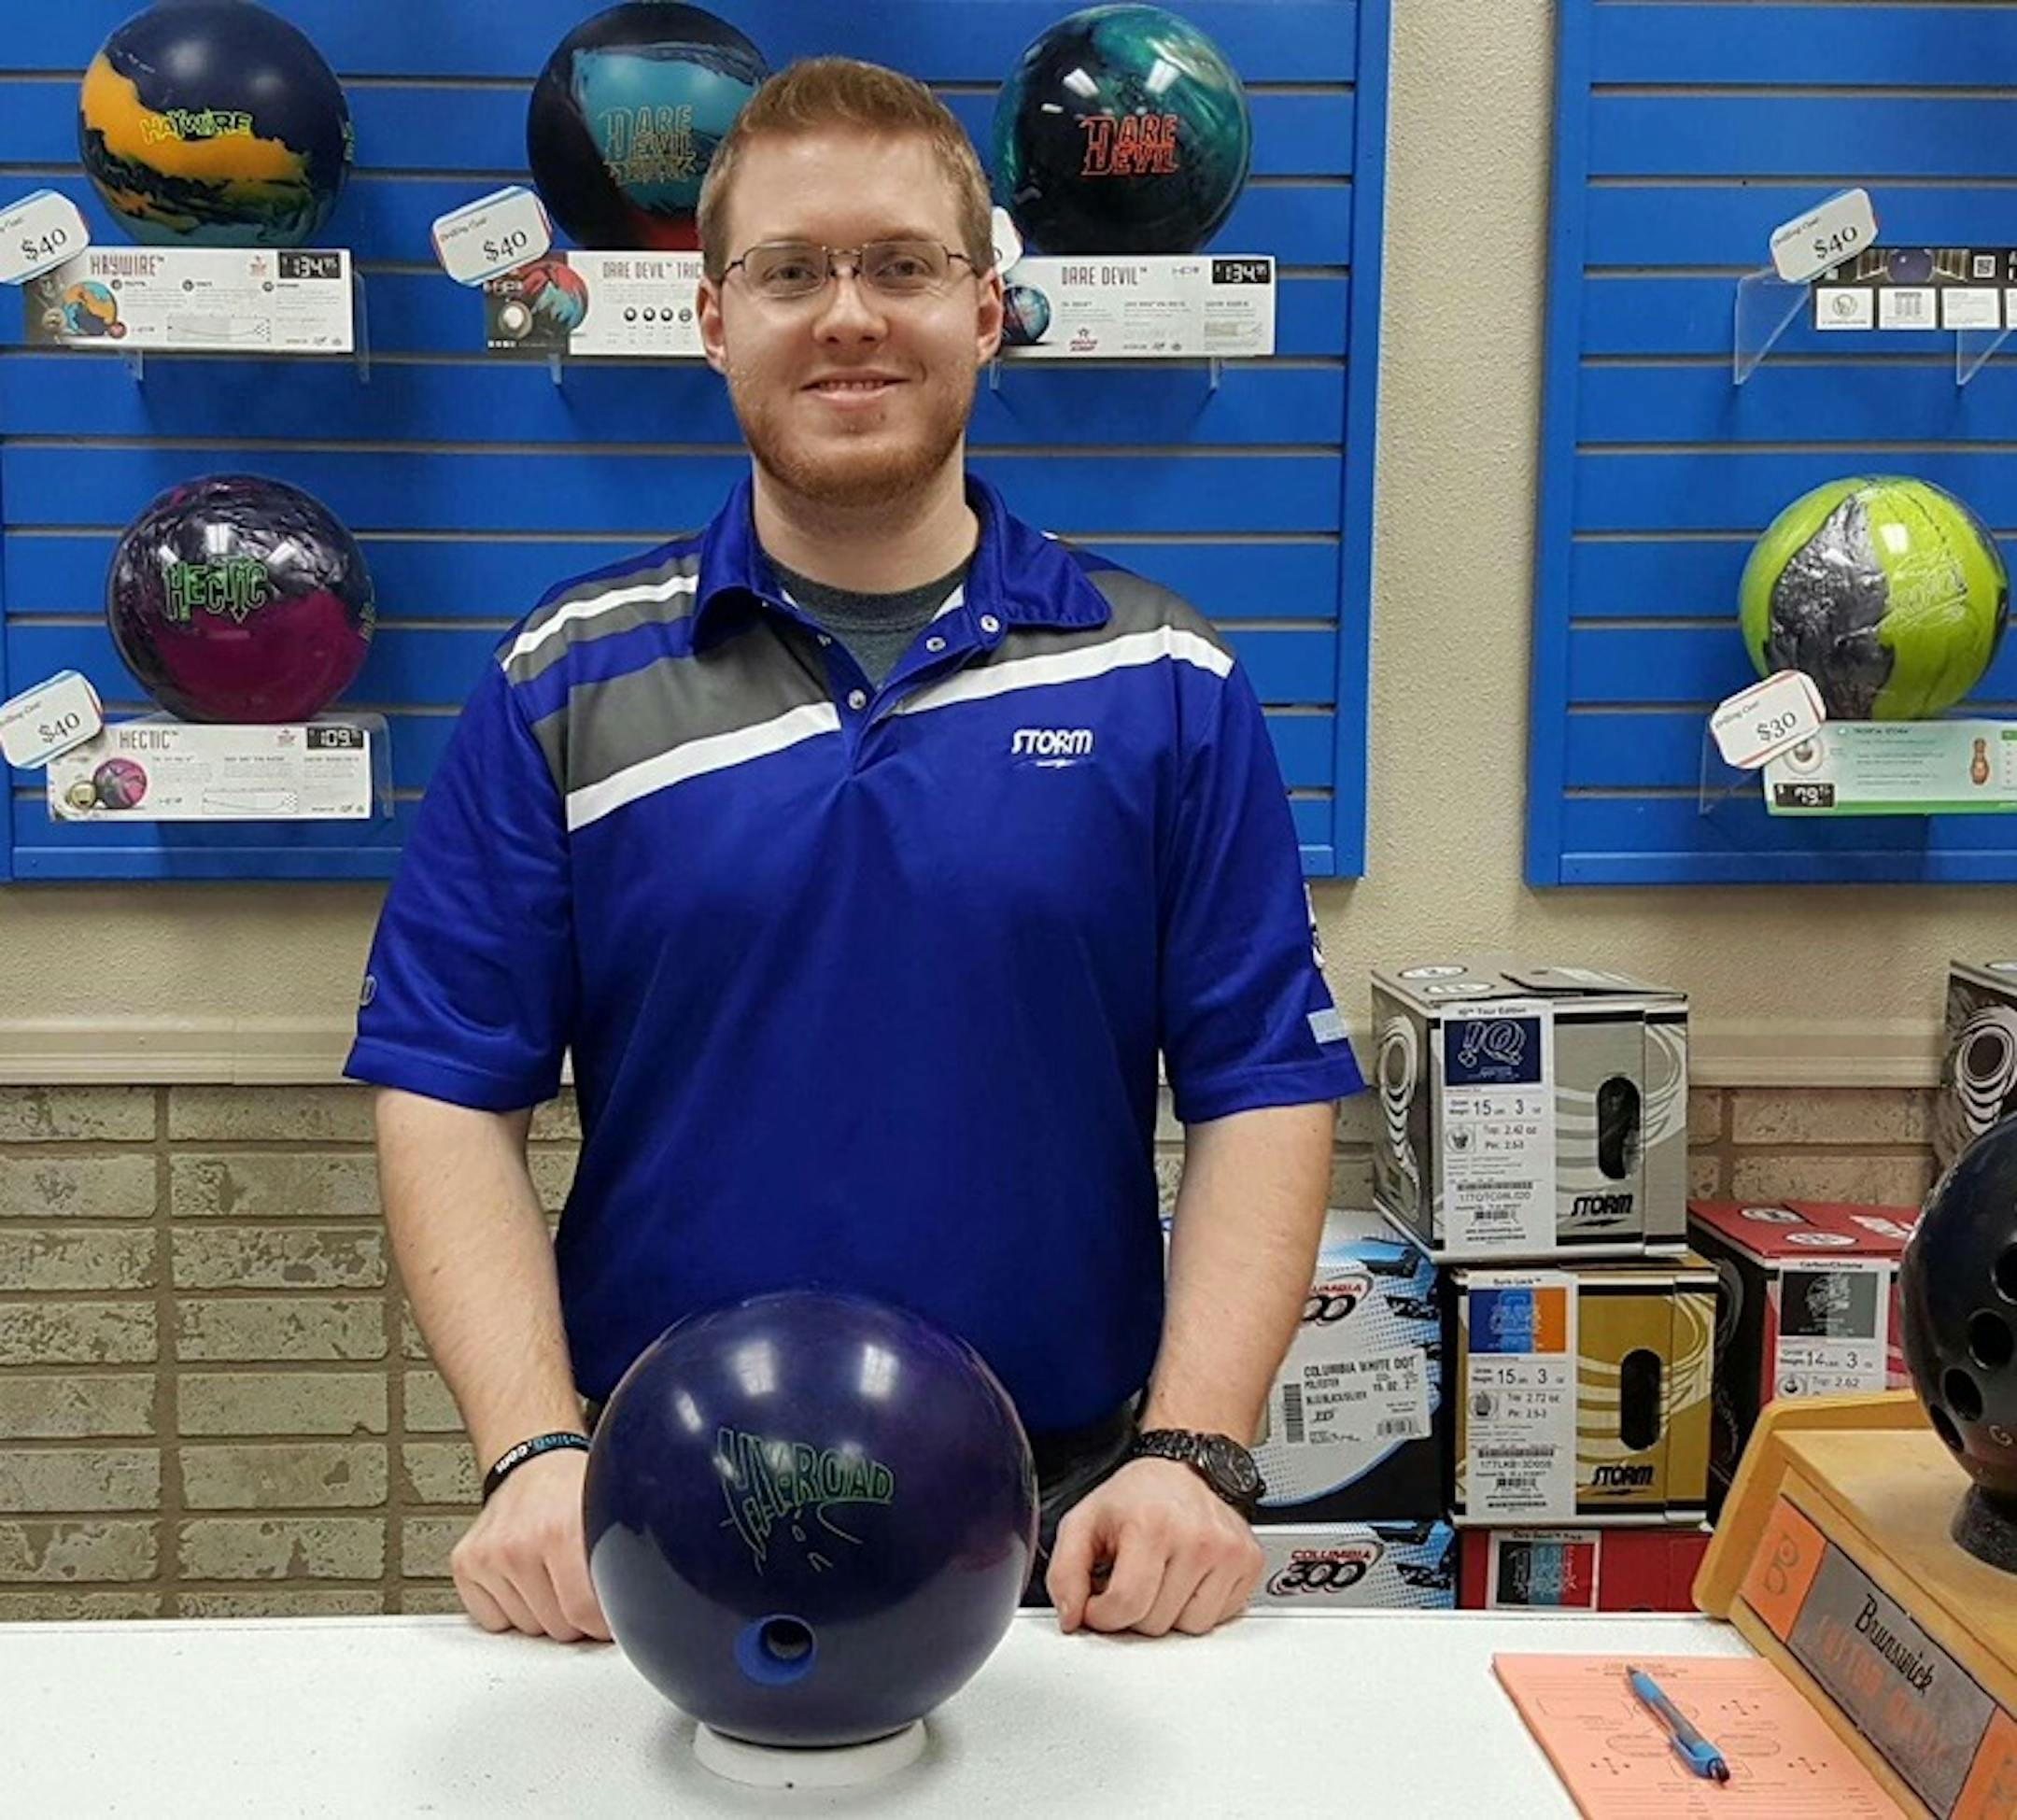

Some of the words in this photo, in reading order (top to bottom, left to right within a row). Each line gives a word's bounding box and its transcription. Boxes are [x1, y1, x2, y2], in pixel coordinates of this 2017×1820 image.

[1081, 141, 1179, 176] DEVIL
[21, 228, 66, 262] $40
[483, 230, 527, 262] $40
[1813, 227, 1857, 260] $40
[1062, 266, 1095, 285] DARE
[164, 555, 269, 624] HECTIC
[38, 712, 80, 743] $40
[1757, 712, 1797, 741] $30
[1011, 728, 1093, 755] STORM
[1474, 1098, 1492, 1116] 15
[1516, 1098, 1524, 1115] 3
[1572, 1194, 1632, 1216] STORM
[1302, 1294, 1356, 1322] 00
[1304, 1362, 1356, 1377] COLUMBIA
[1359, 1359, 1389, 1373] WHITE
[1394, 1355, 1416, 1370] DOT
[1846, 1351, 1858, 1369] 3
[1498, 1368, 1516, 1384] 15
[1538, 1368, 1547, 1384] 3
[1592, 1465, 1653, 1487] STORM
[1291, 1550, 1371, 1561] COLUMBIA
[1281, 1560, 1366, 1587] 300
[1855, 1592, 1936, 1698] Brunswick
